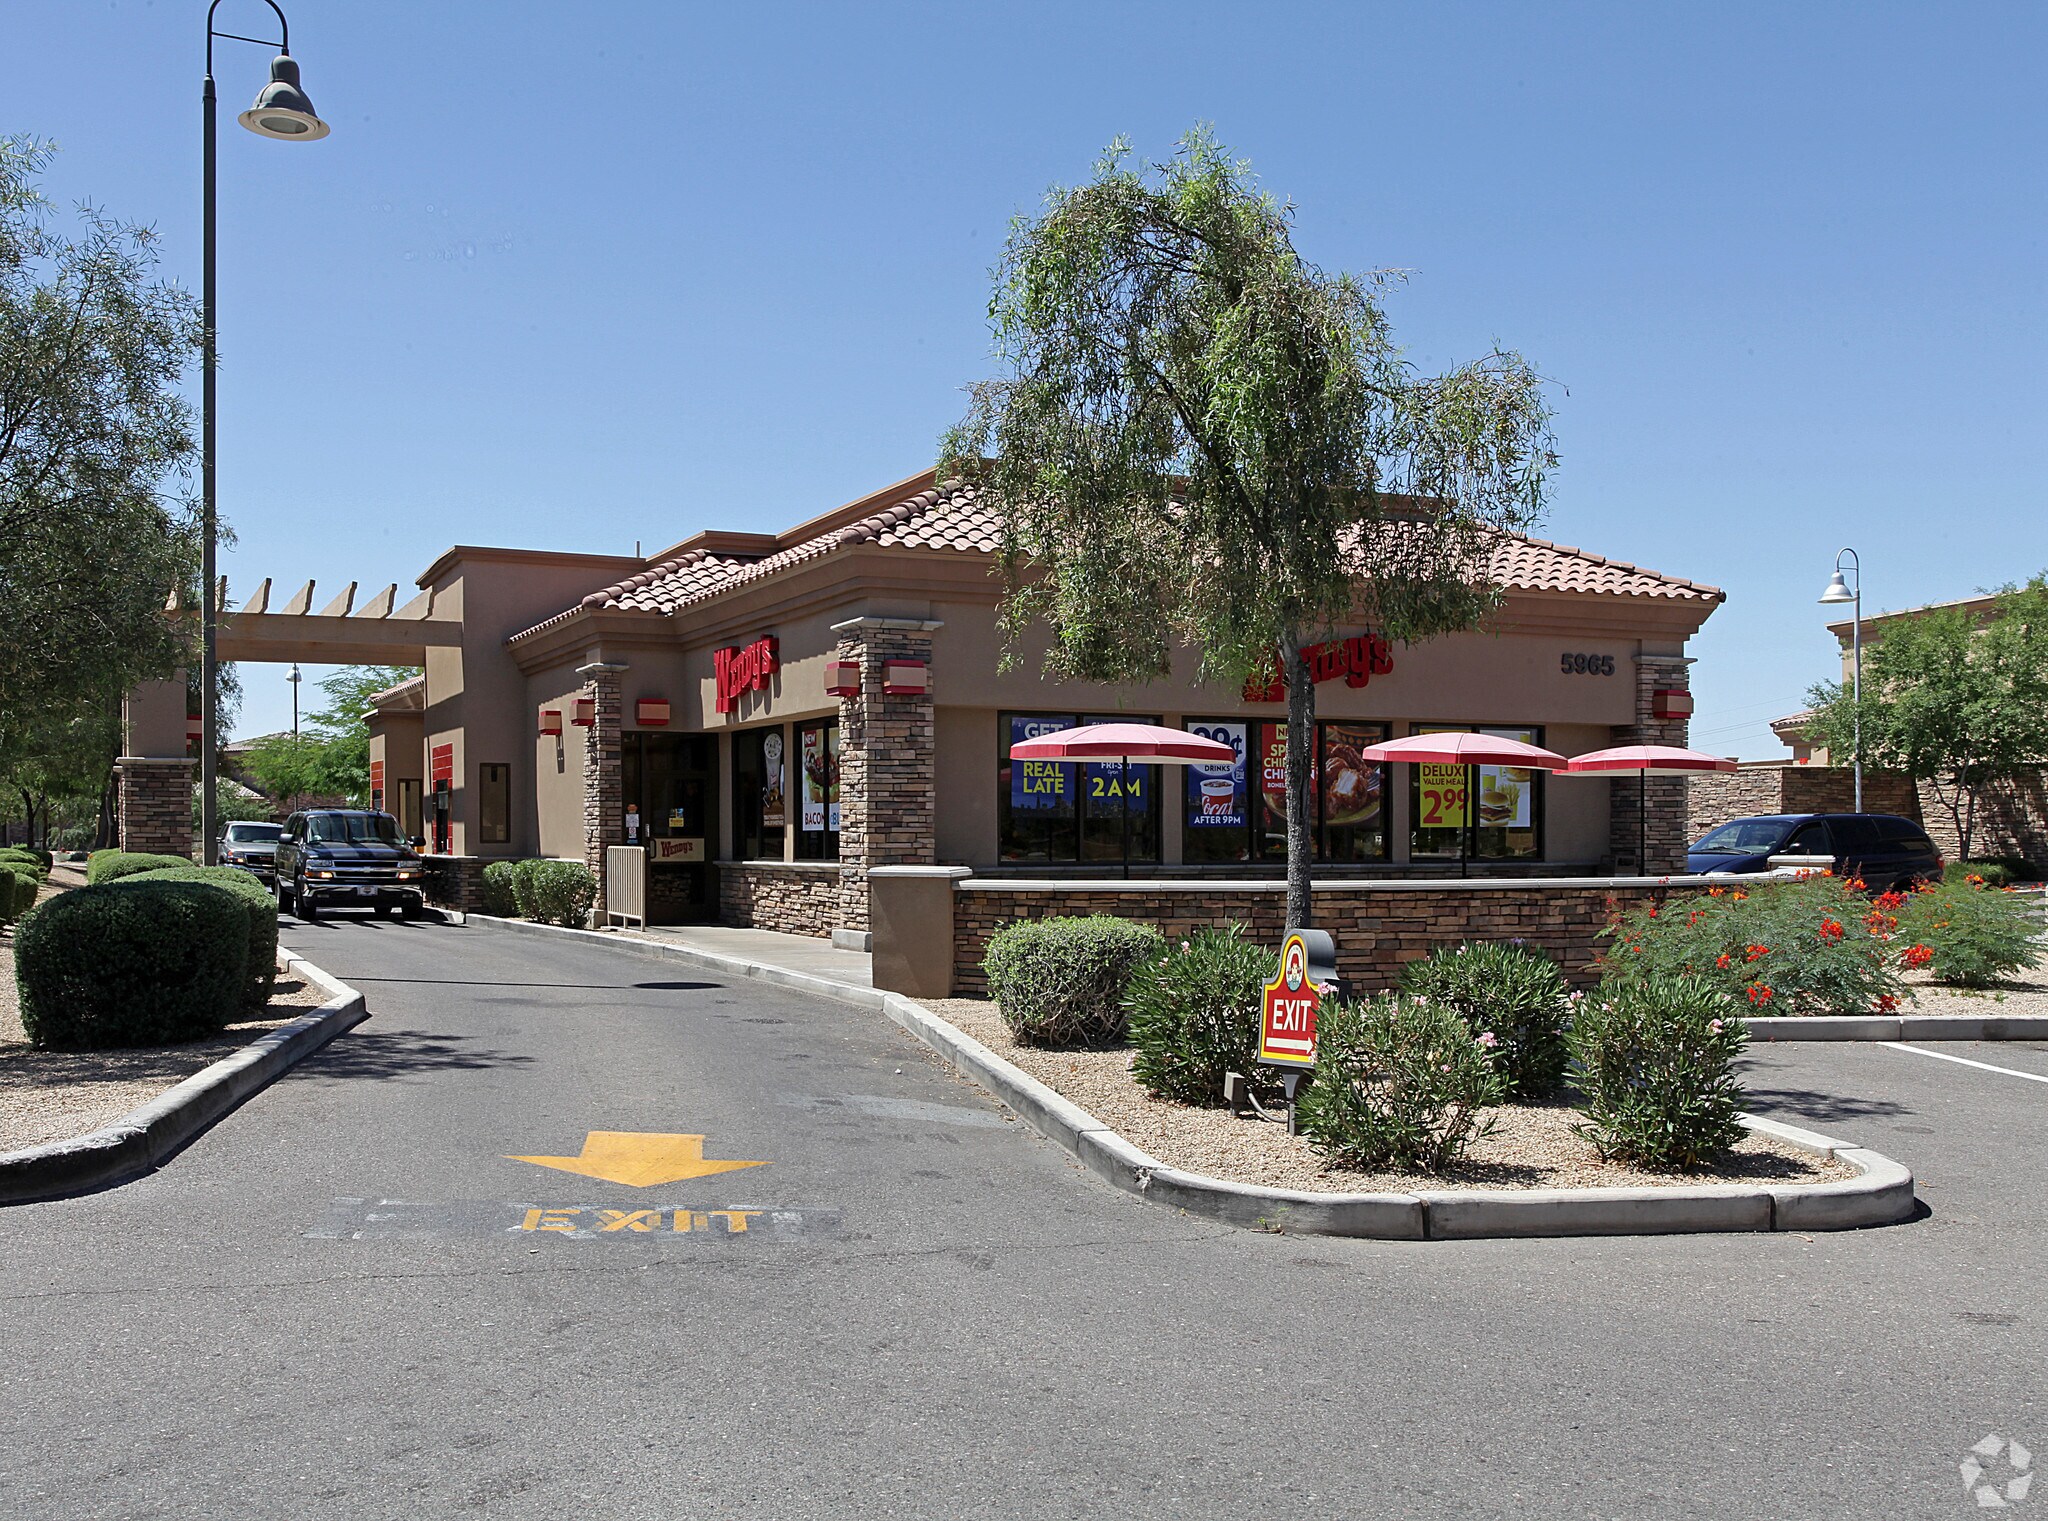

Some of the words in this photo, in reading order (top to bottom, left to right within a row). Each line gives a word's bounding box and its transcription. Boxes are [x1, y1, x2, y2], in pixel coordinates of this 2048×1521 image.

[714, 635, 779, 713] Wendy's
[1561, 653, 1616, 677] 5965
[1023, 762, 1064, 777] REAL
[1023, 778, 1064, 794] LATE
[1423, 777, 1445, 786] VALUE
[1194, 815, 1221, 824] AFTER
[1222, 815, 1241, 824] 9PM
[660, 840, 693, 858] Wendy's
[1272, 998, 1312, 1032] EXIT
[521, 1208, 764, 1233] EXIT
